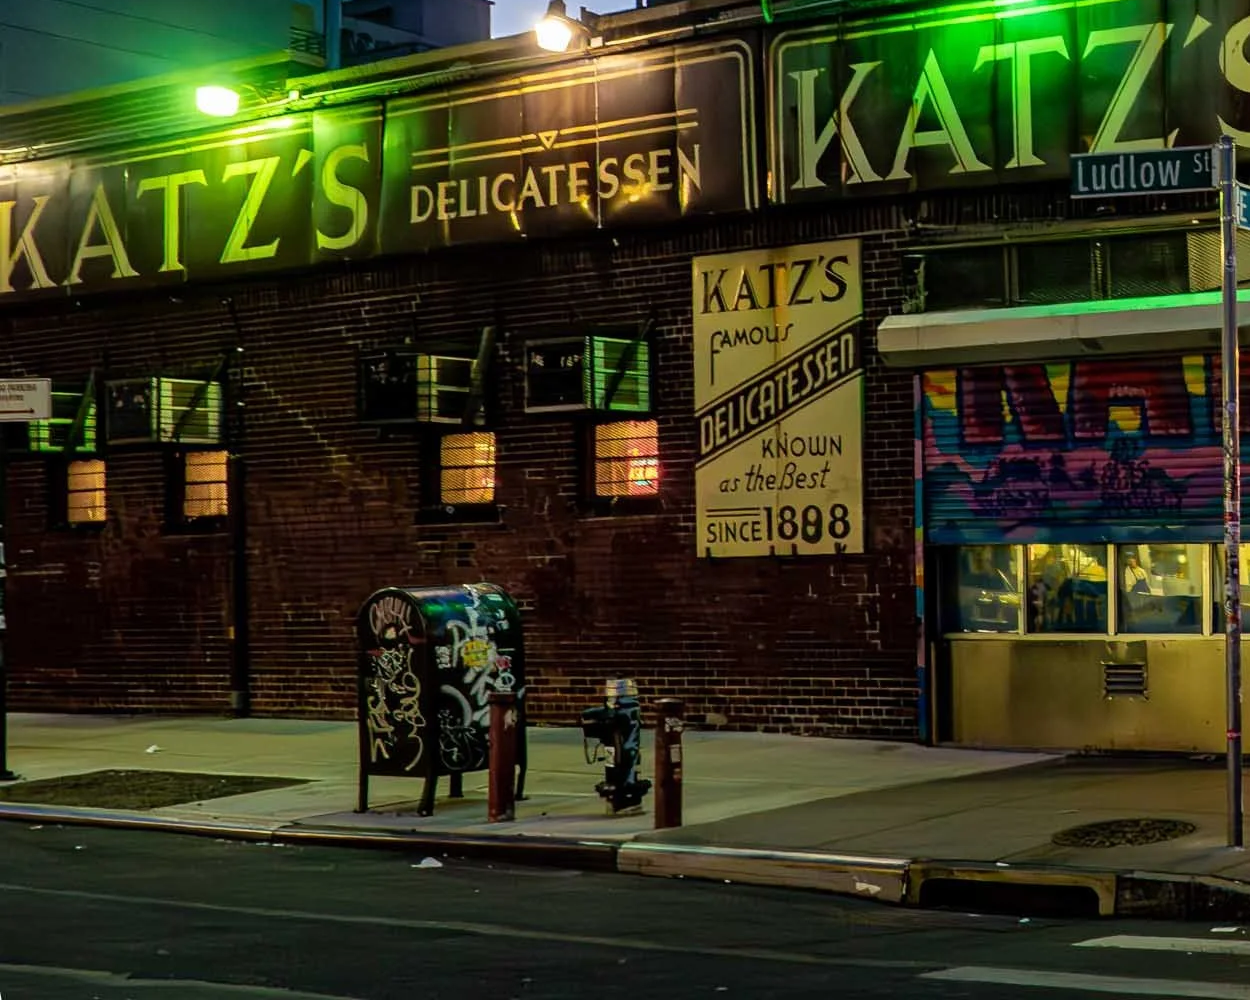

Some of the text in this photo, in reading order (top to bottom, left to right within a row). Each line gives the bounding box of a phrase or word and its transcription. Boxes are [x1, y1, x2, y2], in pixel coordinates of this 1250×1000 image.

[1077, 152, 1211, 192] Ludlow St
[0, 143, 701, 293] KATZ'S DELICATESSEN
[1239, 190, 1248, 223] E
[700, 255, 849, 315] KATZ'S
[762, 433, 842, 459] KNOWN
[719, 460, 831, 493] as the Best
[706, 521, 762, 543] SINCE
